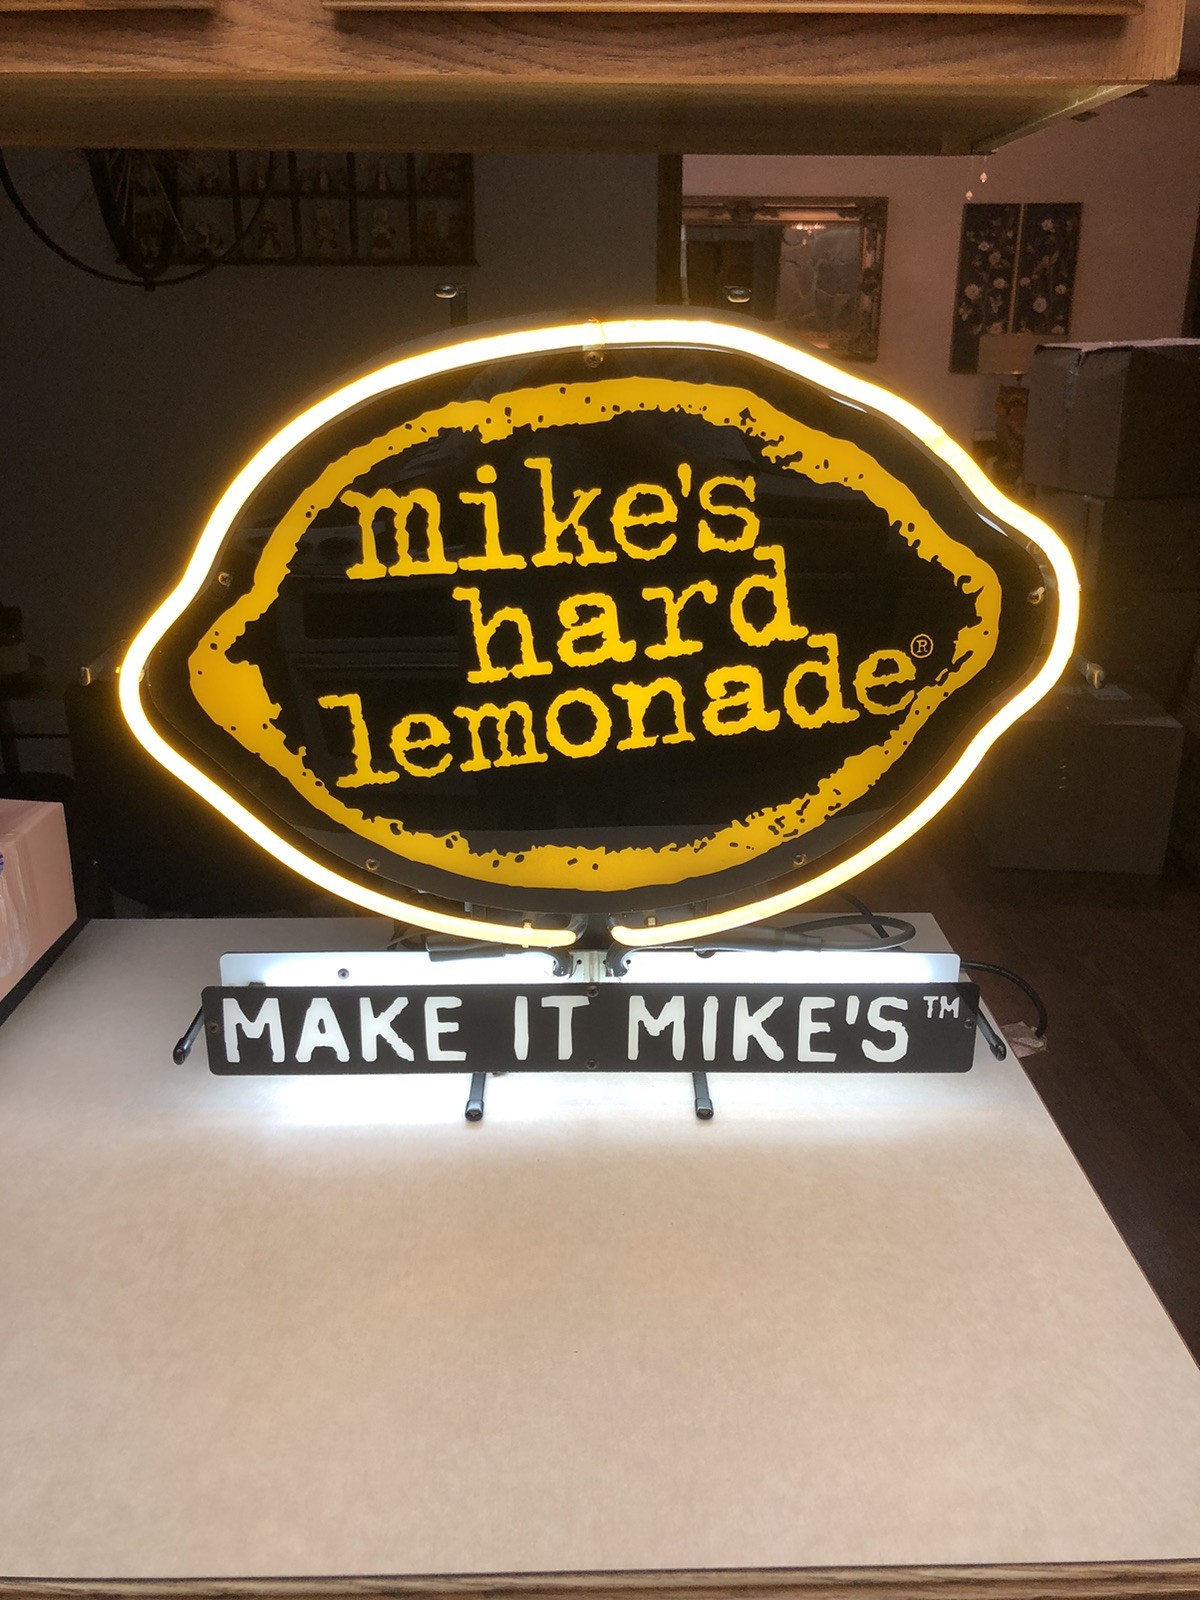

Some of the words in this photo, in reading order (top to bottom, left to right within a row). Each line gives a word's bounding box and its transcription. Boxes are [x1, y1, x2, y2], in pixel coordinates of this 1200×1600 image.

[339, 456, 761, 582] mike's
[451, 544, 810, 684] hard
[222, 996, 467, 1063] MAKE
[513, 995, 590, 1061] IT
